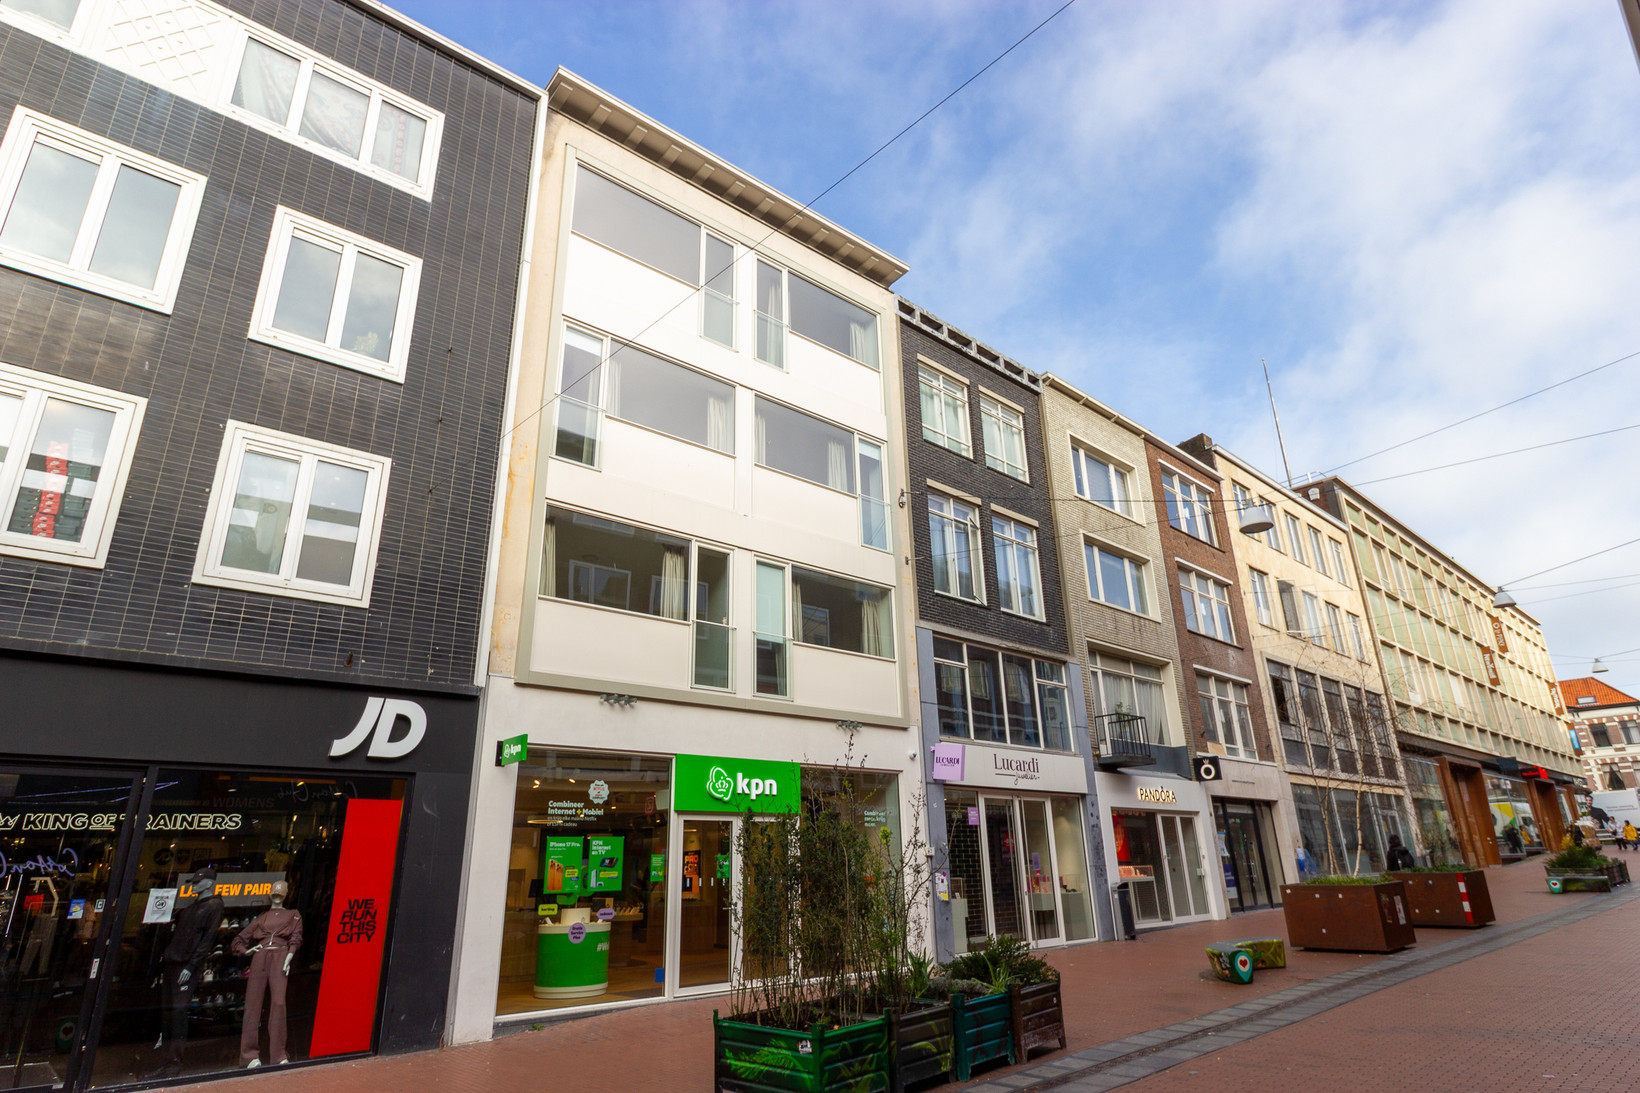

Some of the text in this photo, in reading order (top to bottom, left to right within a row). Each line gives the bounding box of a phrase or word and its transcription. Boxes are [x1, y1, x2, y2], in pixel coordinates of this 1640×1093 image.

[328, 696, 428, 758] JD
[510, 744, 522, 756] kpn
[935, 756, 960, 765] LUCARDI
[993, 753, 1040, 773] Lucardi
[736, 772, 778, 800] kpn
[1138, 786, 1177, 803] PANDORA
[548, 800, 585, 808] Combineer
[582, 808, 604, 816] Mobiel
[22, 813, 242, 830] KING OF RAINERS
[214, 884, 242, 896] FEW
[348, 899, 375, 910] WE
[341, 909, 377, 921] RUN
[339, 920, 377, 932] THIS
[337, 931, 375, 944] CITY
